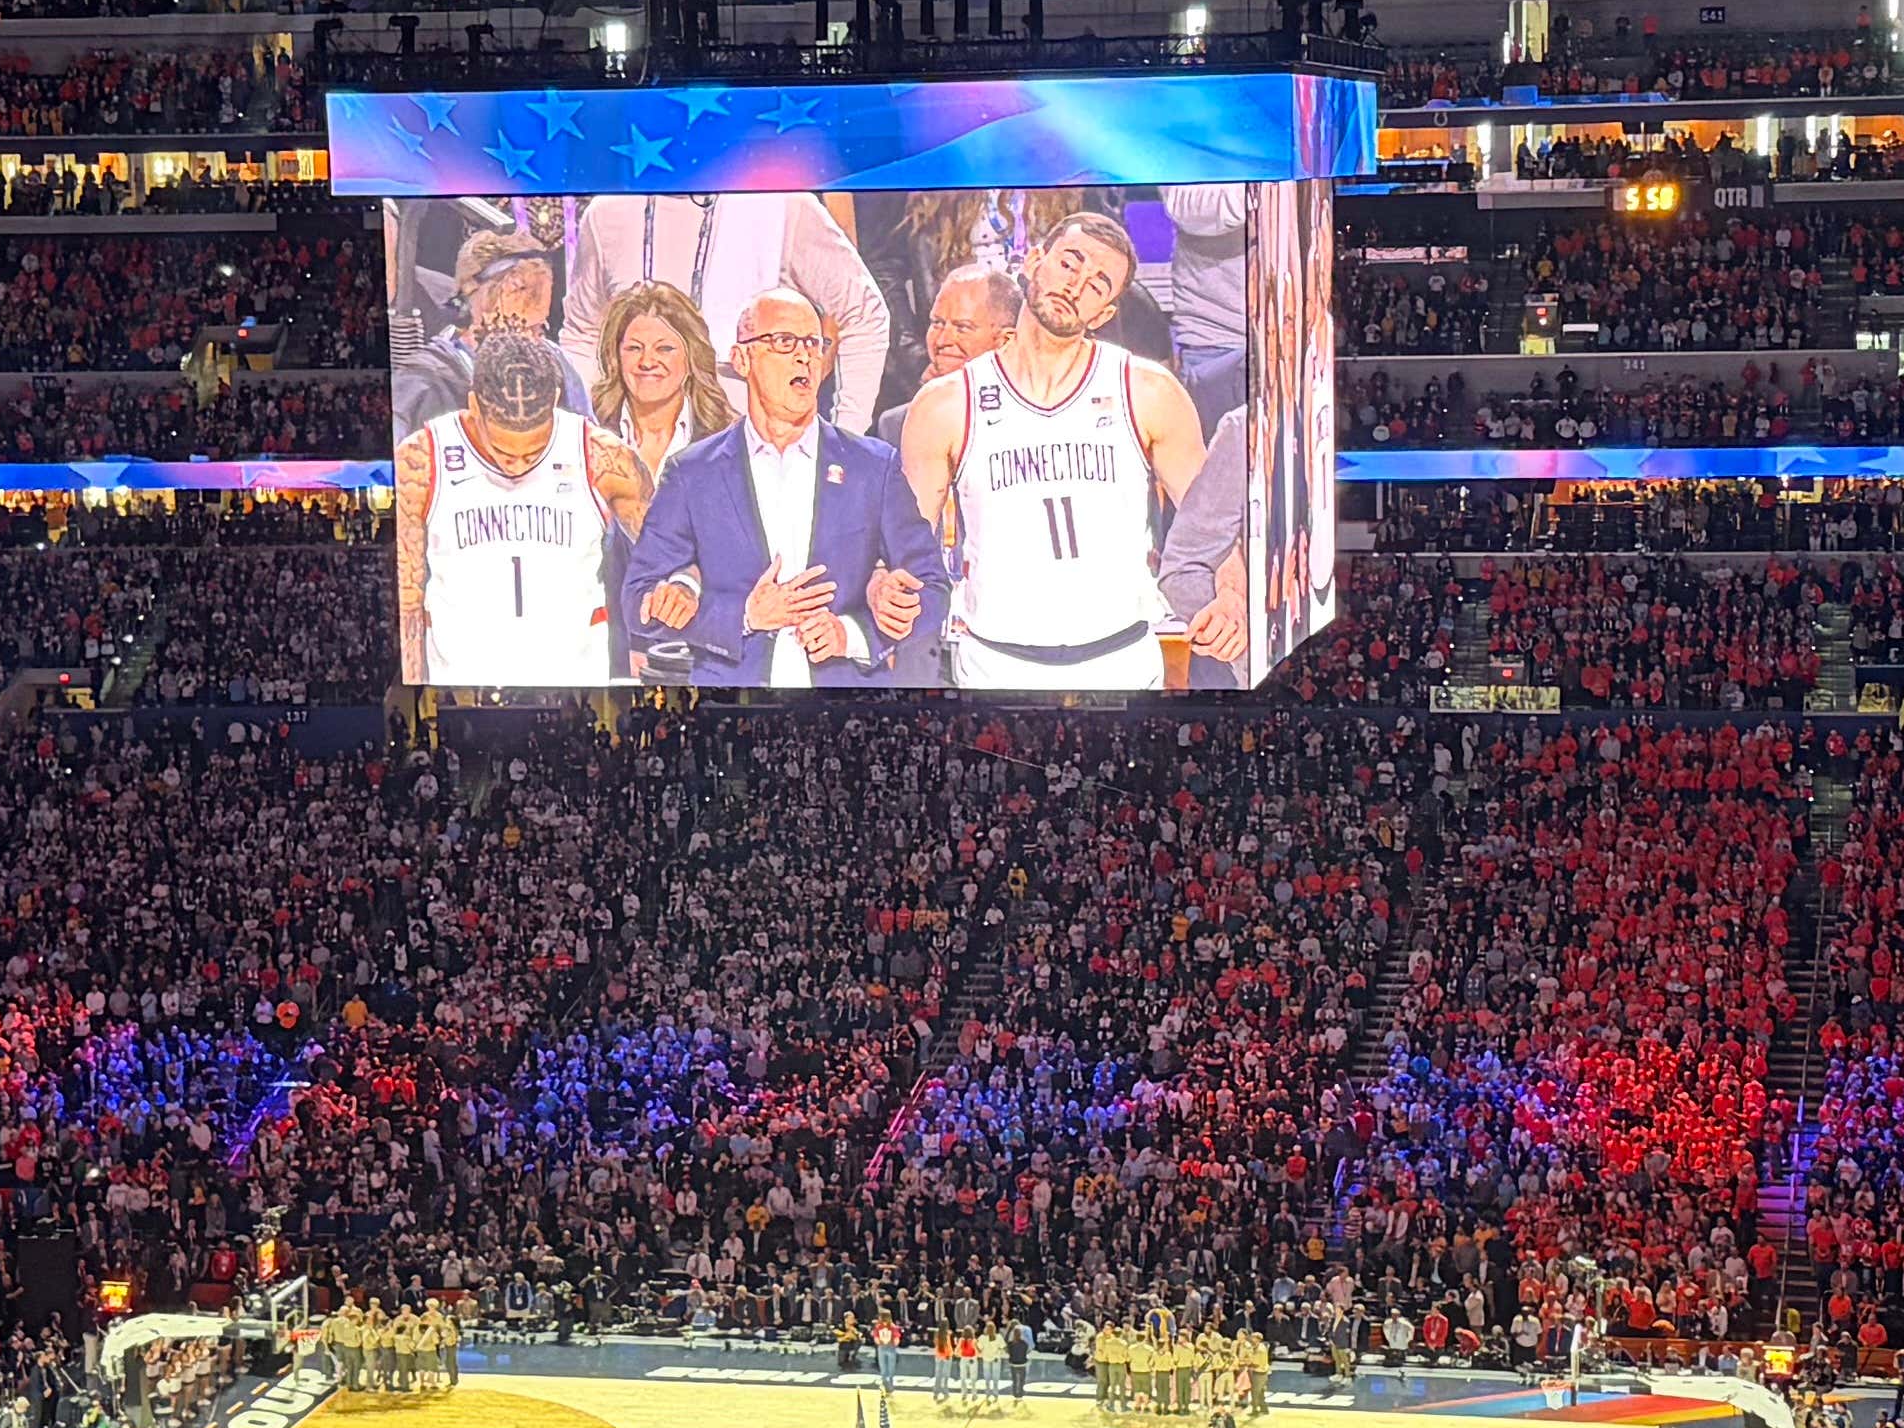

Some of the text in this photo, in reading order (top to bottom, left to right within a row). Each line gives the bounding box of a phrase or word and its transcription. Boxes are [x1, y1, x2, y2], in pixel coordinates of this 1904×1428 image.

[1714, 187, 1748, 209] QTR
[1624, 359, 1646, 372] 341
[989, 443, 1116, 491] CONNECTICUT
[454, 504, 574, 550] CONNECTICUT
[1043, 496, 1079, 560] 11
[511, 556, 523, 617] 1
